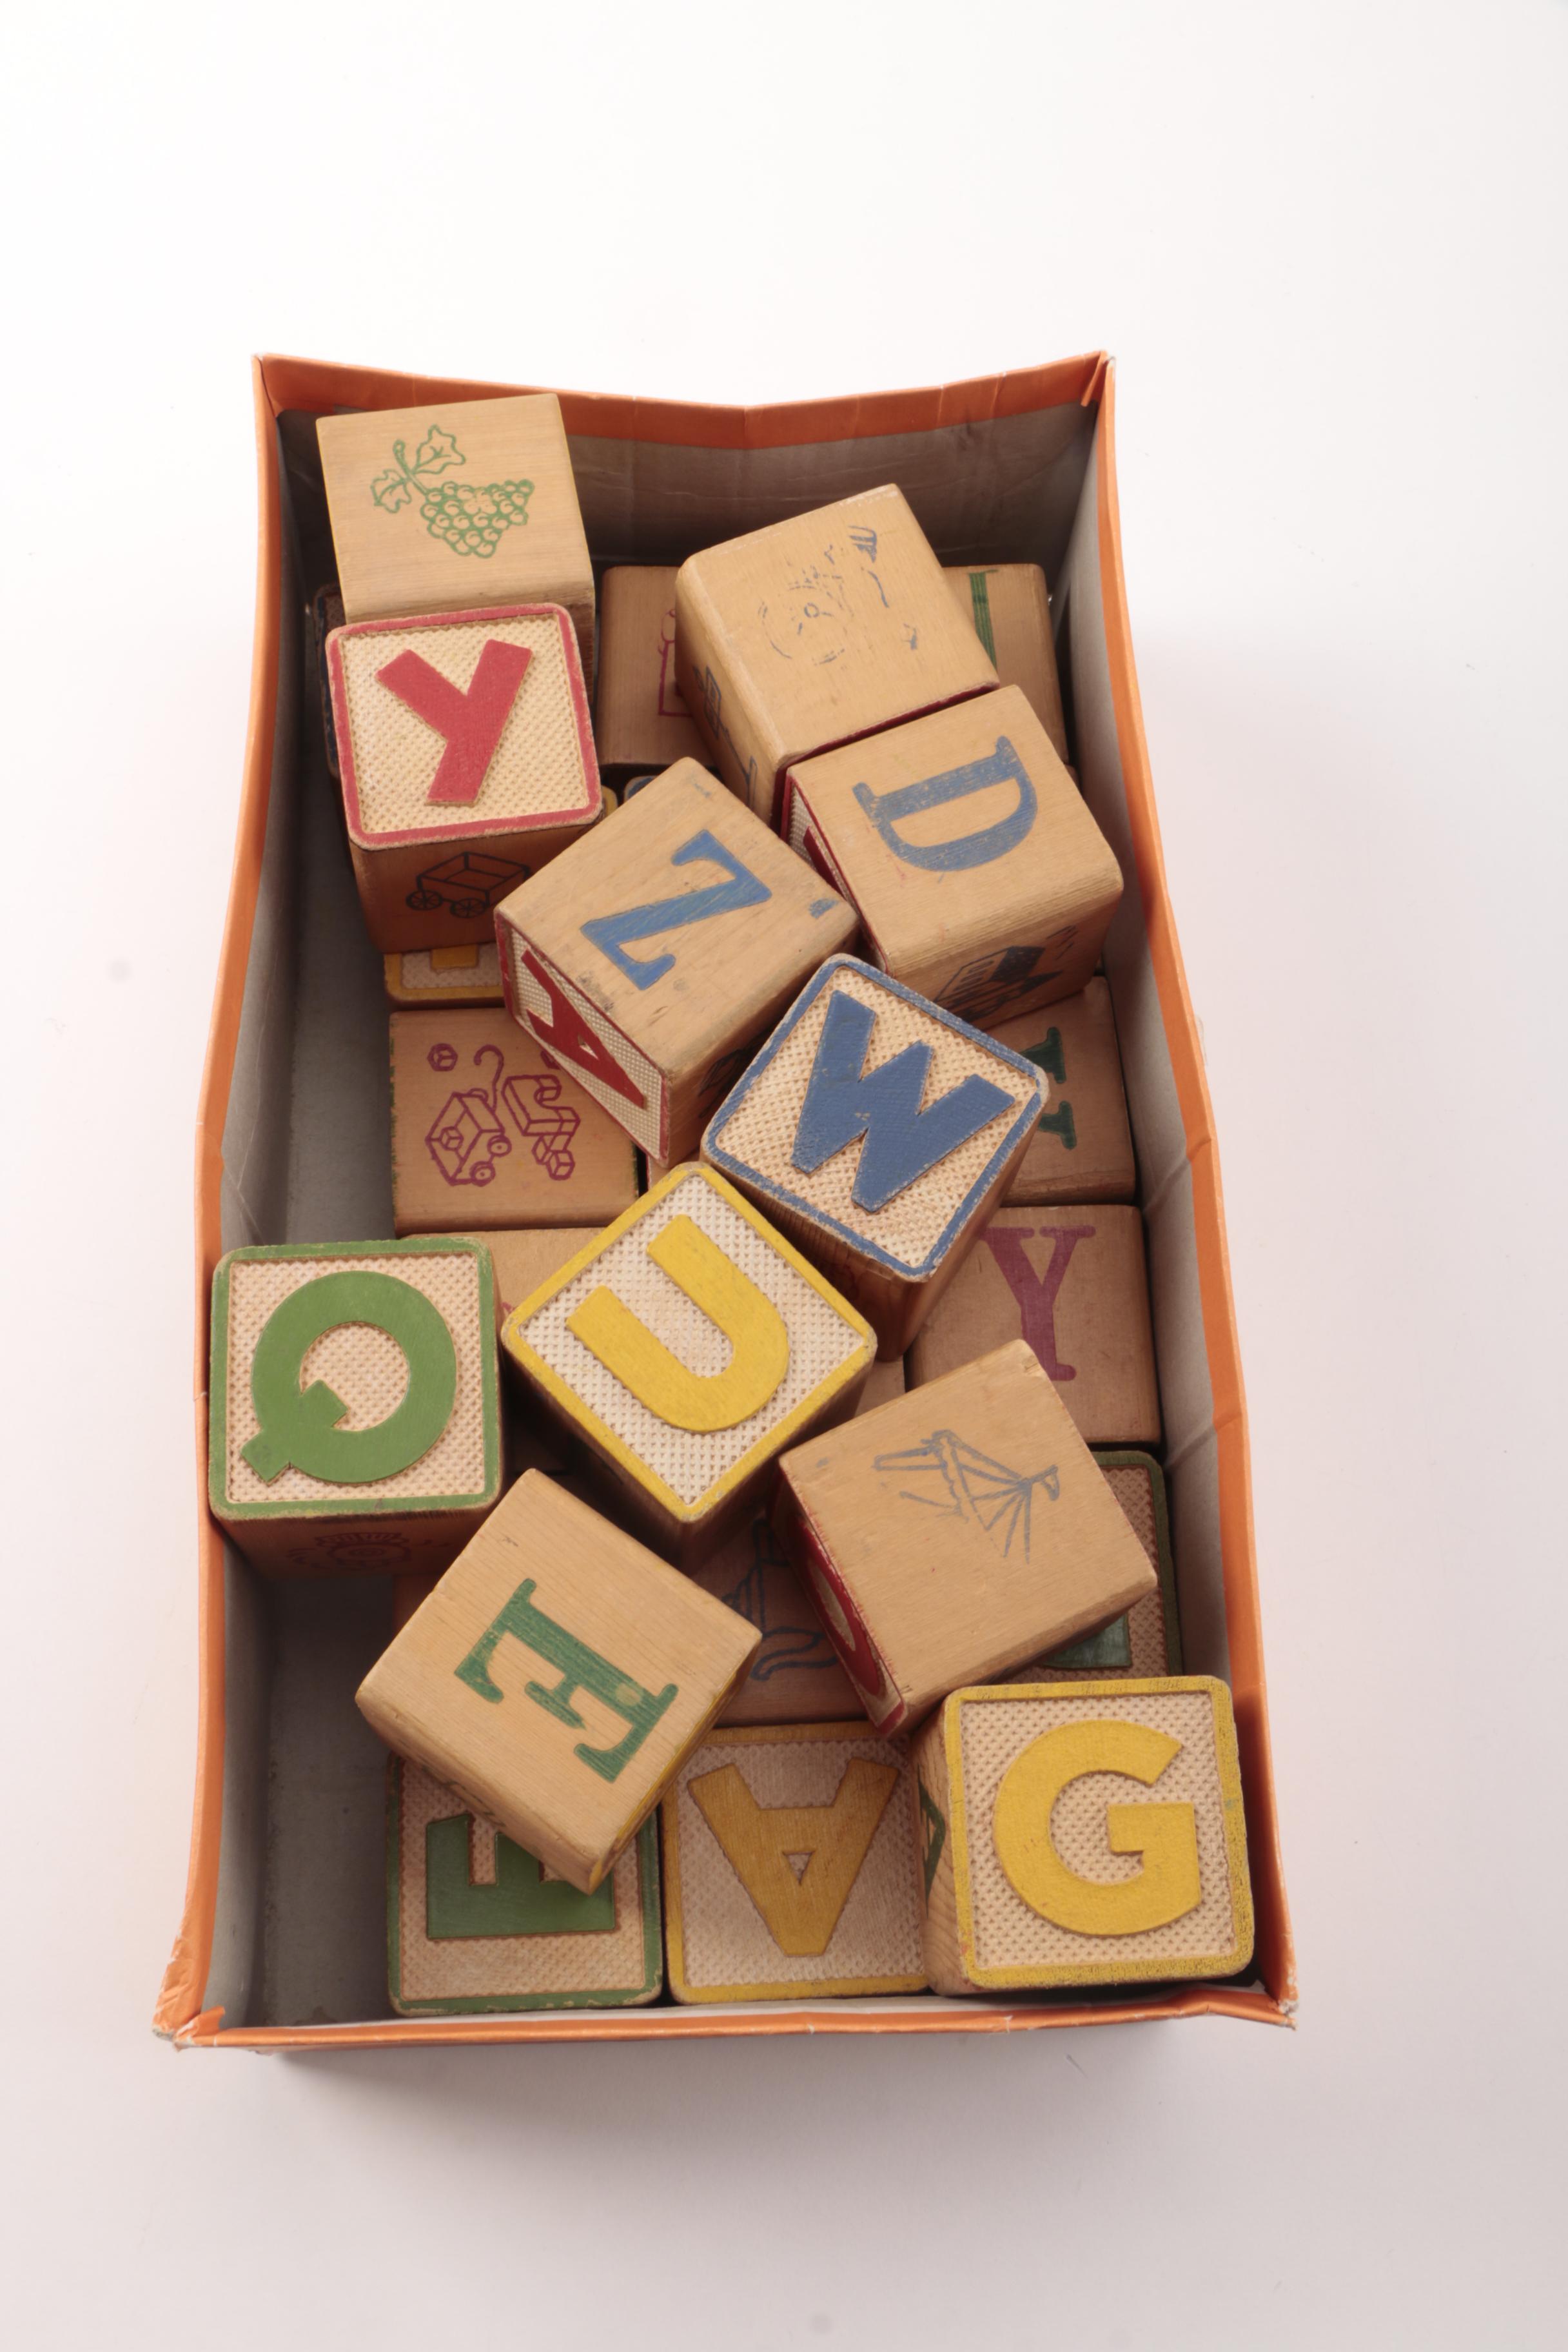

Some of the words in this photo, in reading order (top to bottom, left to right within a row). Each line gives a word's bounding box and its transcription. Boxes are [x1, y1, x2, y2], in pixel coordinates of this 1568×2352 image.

[375, 639, 532, 806] Y
[852, 735, 1038, 873] D
[580, 829, 772, 990] Z
[520, 946, 647, 1110] A
[790, 989, 1016, 1213] W
[239, 1270, 456, 1484] Q
[565, 1214, 790, 1434] U
[979, 1226, 1095, 1381] Y
[454, 1578, 679, 1783] E
[687, 1757, 897, 1957] A
[994, 1719, 1202, 1936] G
